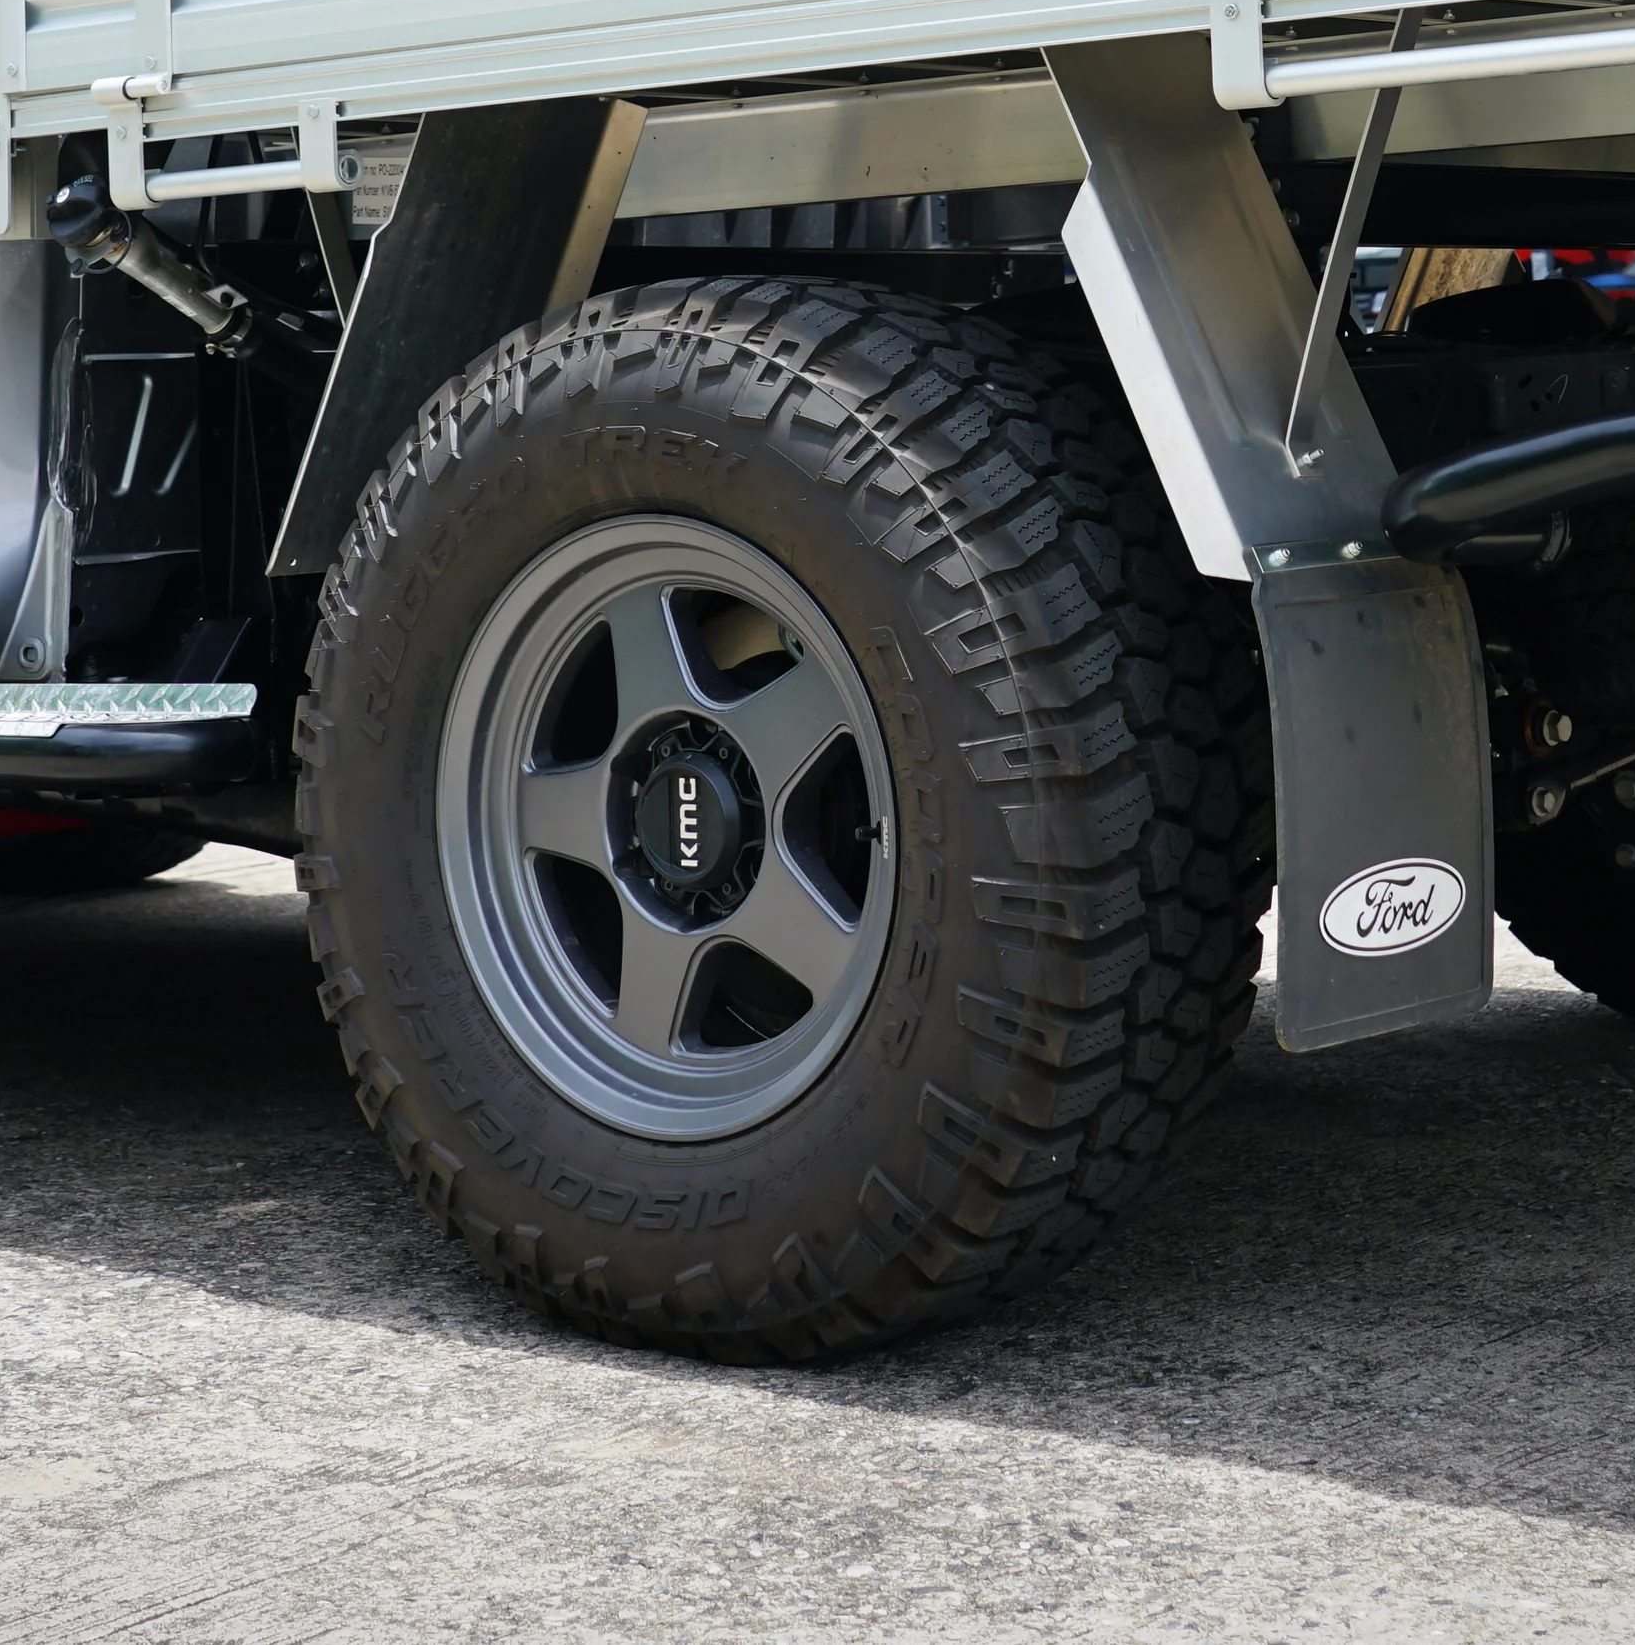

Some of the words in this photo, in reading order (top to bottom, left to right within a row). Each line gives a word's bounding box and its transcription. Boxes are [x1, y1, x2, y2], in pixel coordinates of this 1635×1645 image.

[562, 425, 747, 473] TREK
[869, 624, 946, 1067] COOPER
[1355, 874, 1435, 938] Ford
[379, 951, 755, 1231] DISCOVERER
